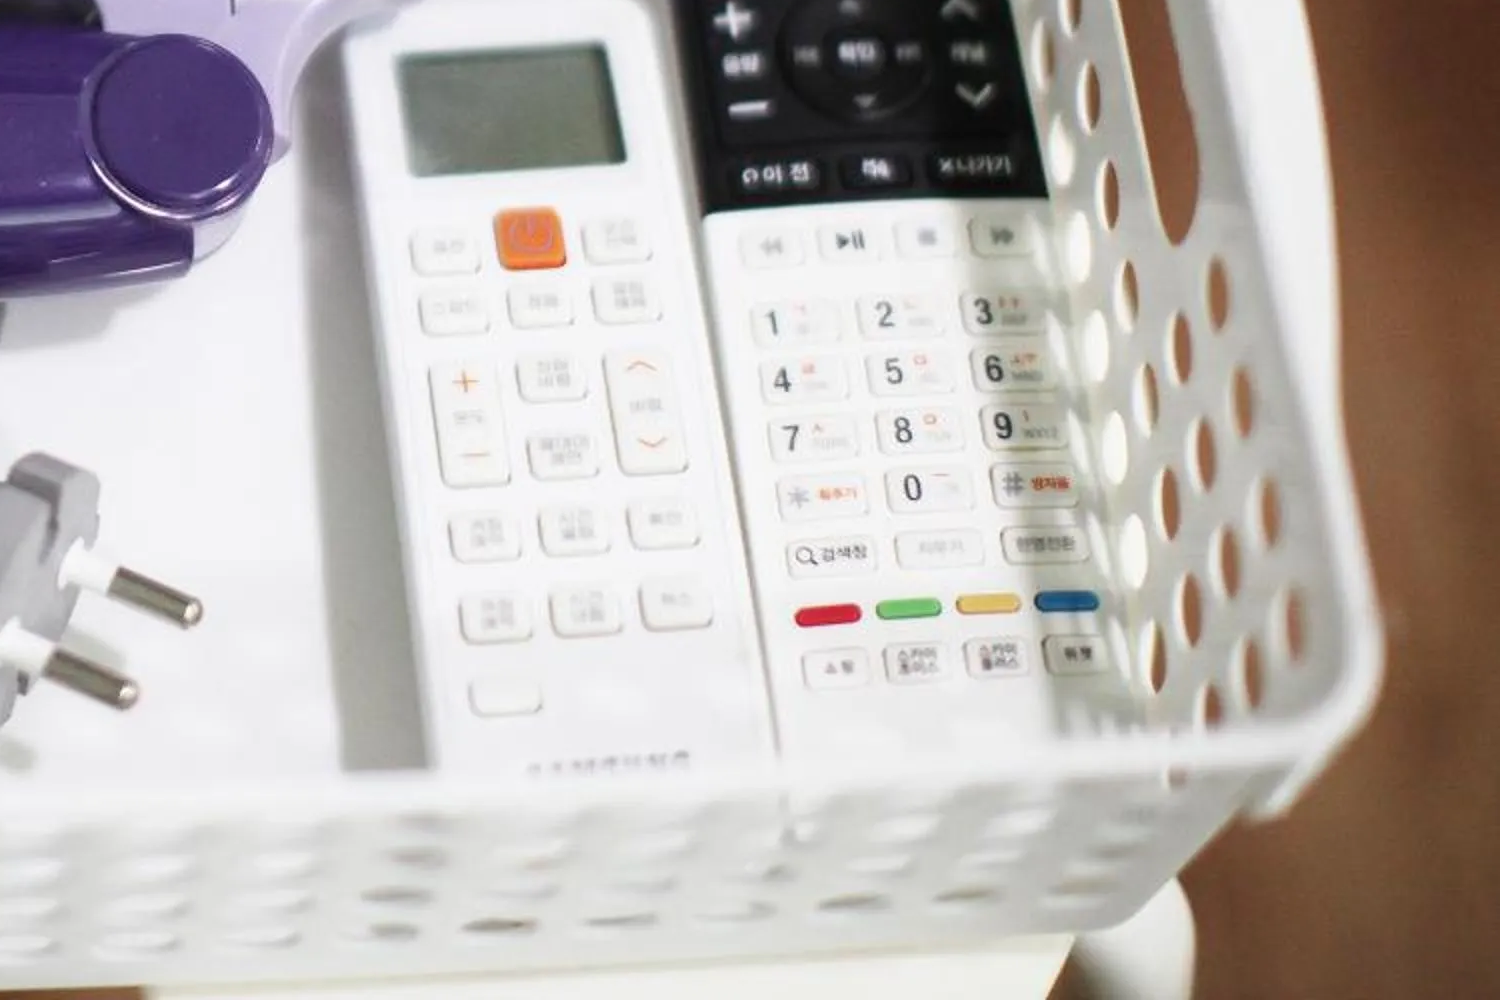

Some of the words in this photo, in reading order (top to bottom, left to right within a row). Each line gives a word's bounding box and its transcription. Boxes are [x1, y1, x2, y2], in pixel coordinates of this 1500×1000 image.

[765, 310, 780, 336] 1
[874, 301, 896, 328] 2
[974, 298, 994, 325] 3
[773, 367, 792, 392] 4
[884, 357, 903, 384] 5
[984, 354, 1004, 382] 6
[781, 424, 800, 451] 7
[894, 416, 913, 444] 8
[994, 411, 1013, 440] 9
[903, 473, 922, 502] 0
[820, 546, 868, 563] 검색창
